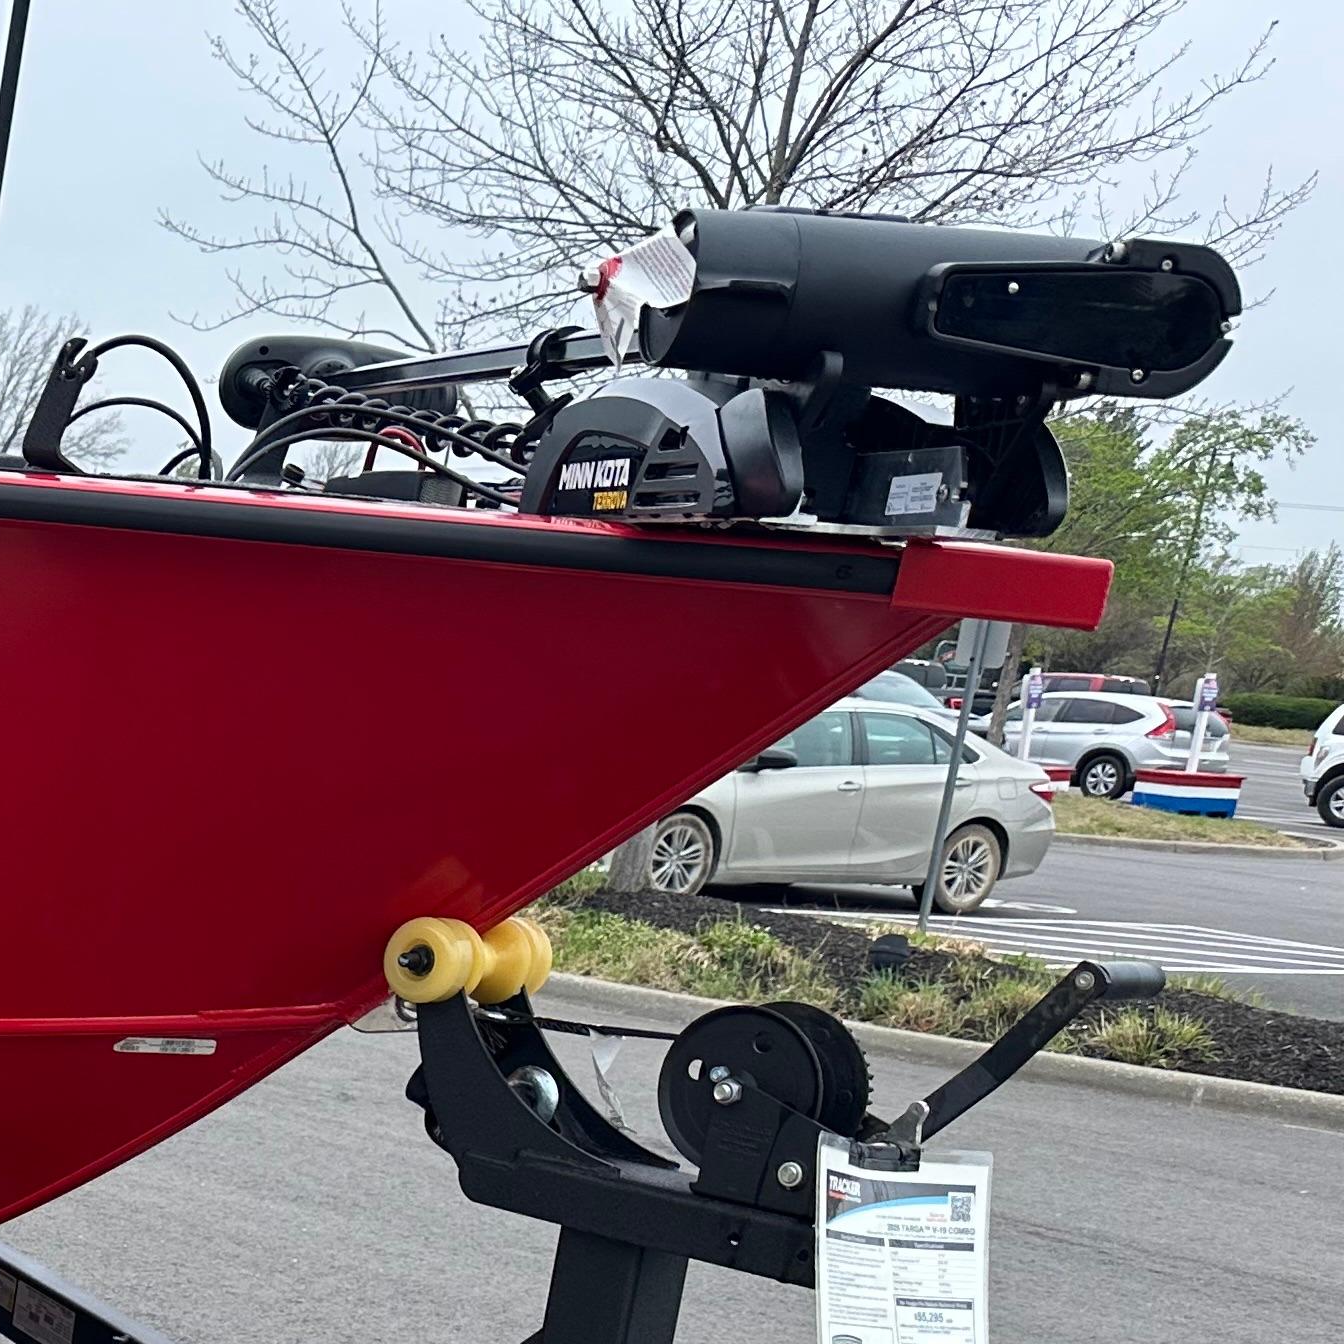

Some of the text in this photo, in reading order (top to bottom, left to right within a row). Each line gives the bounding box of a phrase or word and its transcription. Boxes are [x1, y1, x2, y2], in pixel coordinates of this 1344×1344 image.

[558, 458, 631, 490] MINN KOTA
[829, 1175, 861, 1196] TRACKER
